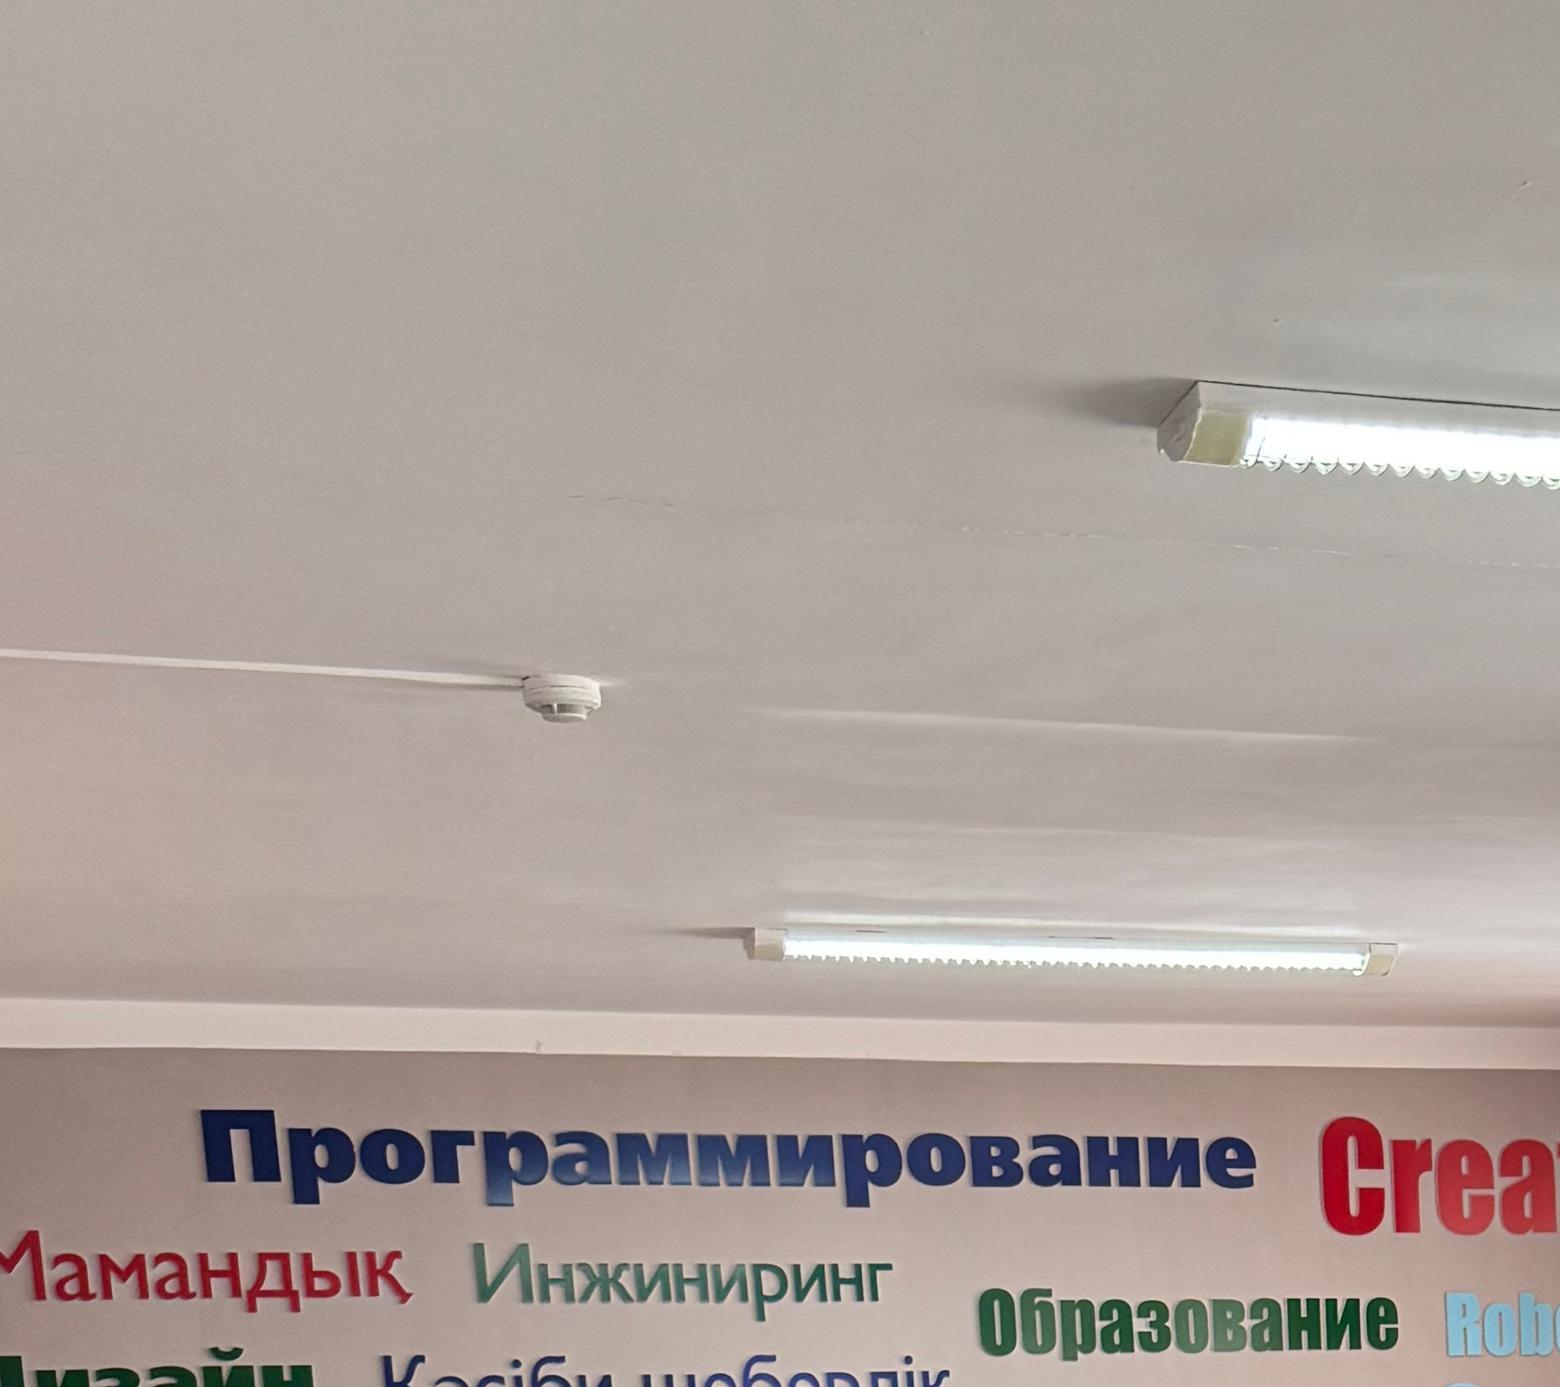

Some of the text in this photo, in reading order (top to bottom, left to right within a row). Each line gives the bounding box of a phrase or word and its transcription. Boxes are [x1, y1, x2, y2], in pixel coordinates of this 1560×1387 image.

[201, 1109, 1257, 1206] Программирование
[0, 1230, 413, 1313] Мамандық
[472, 1243, 893, 1321] Инжиниринг
[977, 1288, 1399, 1360] Образование
